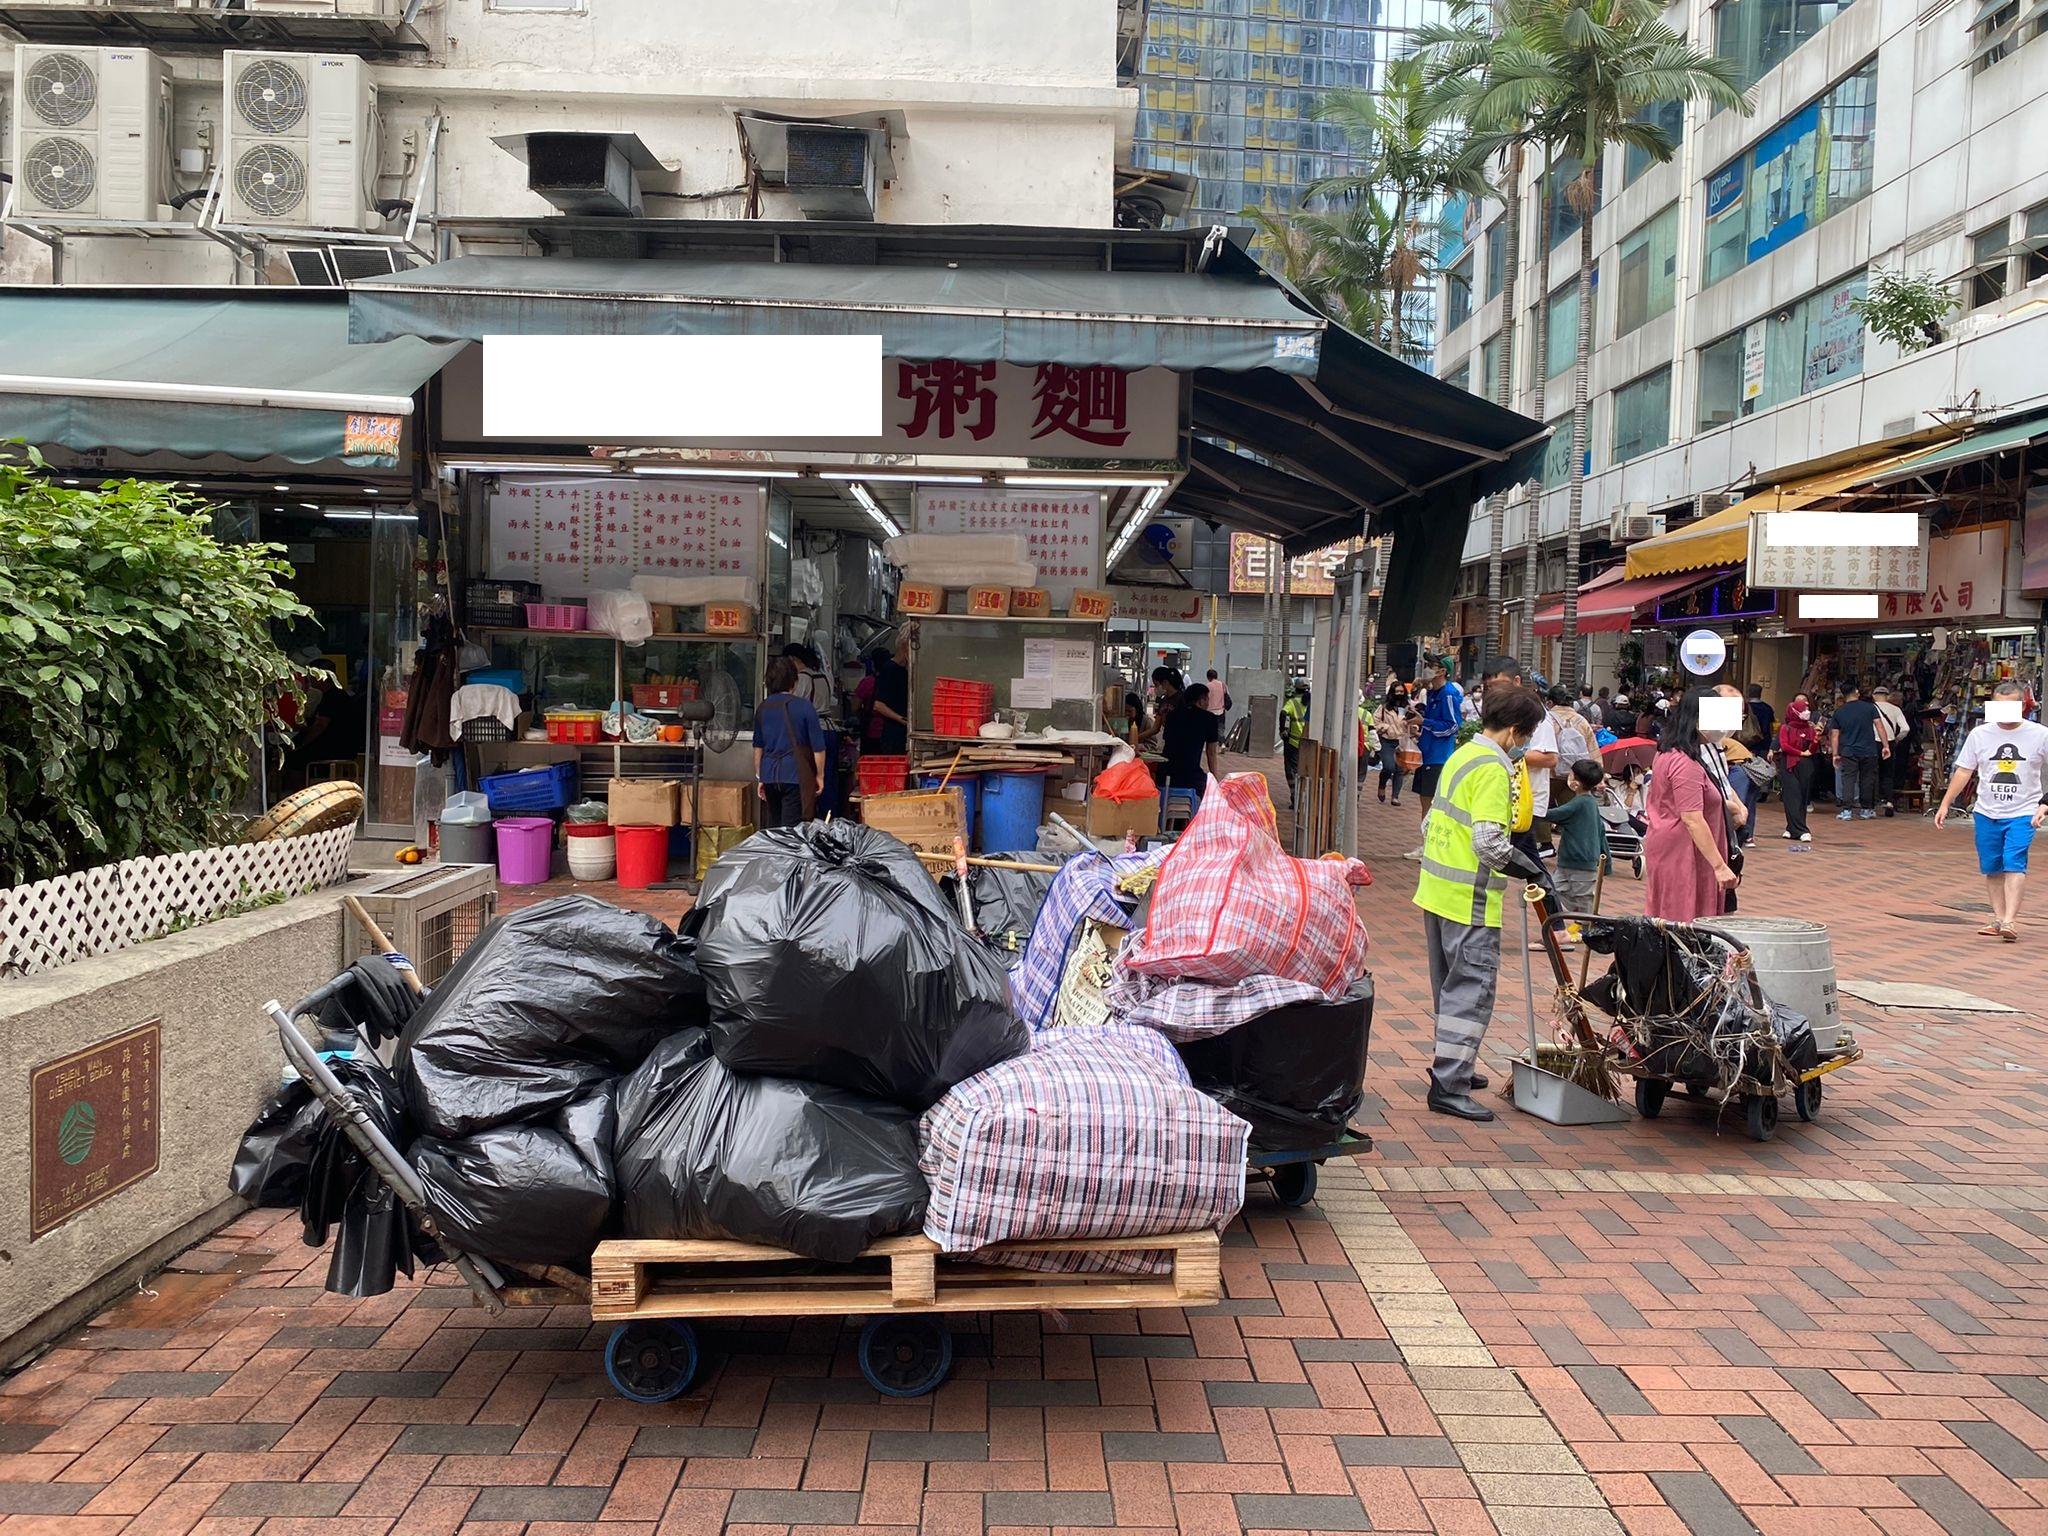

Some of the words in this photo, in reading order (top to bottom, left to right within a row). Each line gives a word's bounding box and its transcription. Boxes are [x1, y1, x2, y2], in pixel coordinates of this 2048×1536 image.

[897, 358, 1131, 447] 粥麵
[1885, 581, 1974, 616] 有限公司
[1990, 785, 2018, 793] LEGO
[1993, 794, 2013, 802] FUN
[48, 1076, 86, 1100] DISTRICT
[90, 1064, 113, 1083] BOARD
[55, 1068, 80, 1085] TSUEN
[87, 1058, 103, 1072] WAN
[61, 1182, 76, 1198] TAK
[86, 1164, 110, 1186] COURT
[89, 1178, 107, 1194] AREA
